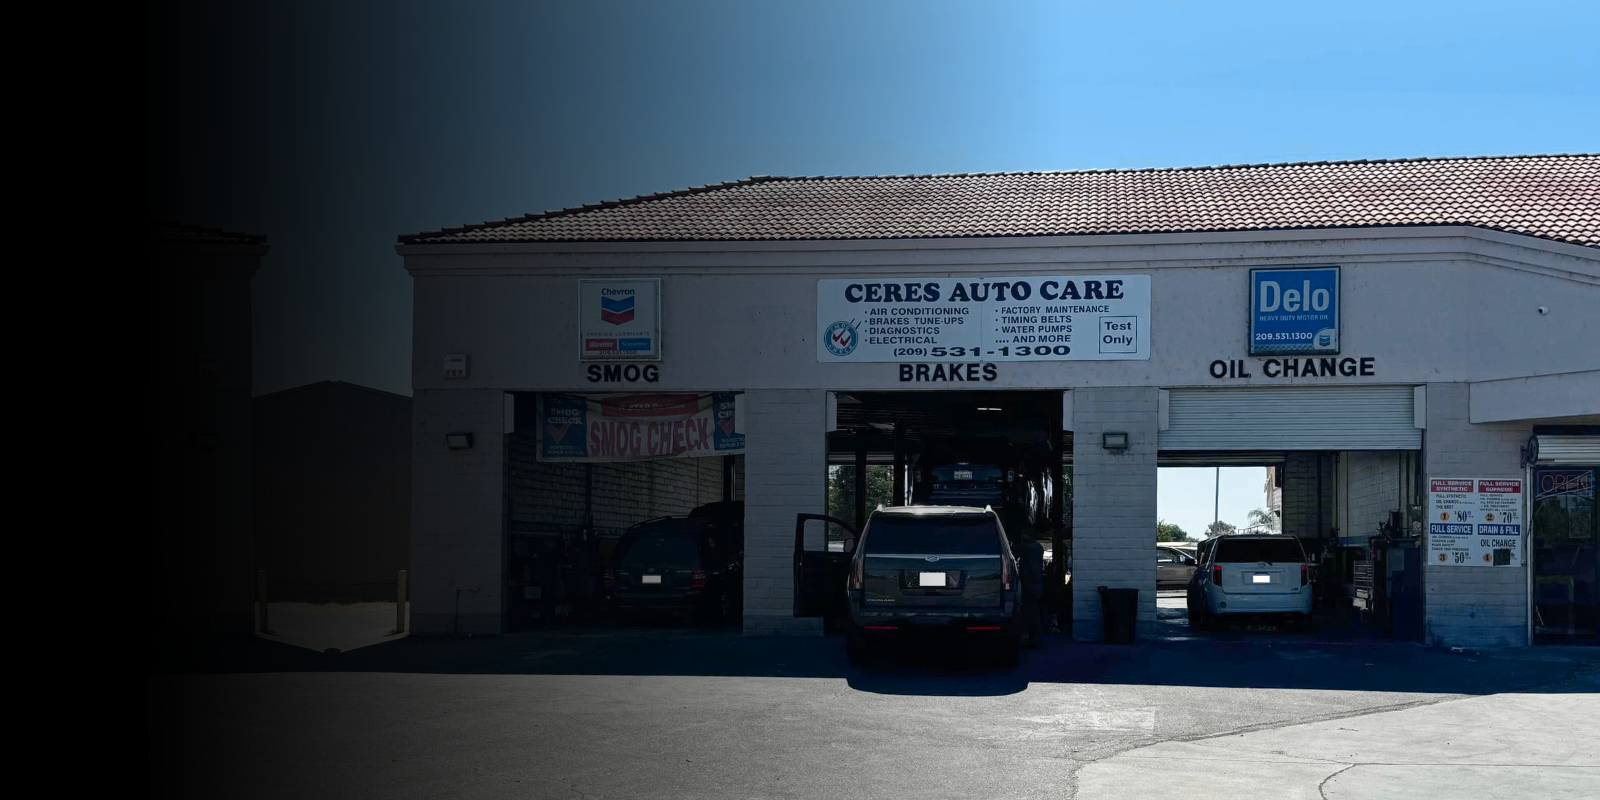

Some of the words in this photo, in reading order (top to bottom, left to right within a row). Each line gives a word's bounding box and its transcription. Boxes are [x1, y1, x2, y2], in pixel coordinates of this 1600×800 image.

[601, 288, 635, 296] Chevron
[845, 283, 940, 303] CERES
[948, 281, 1031, 302] AUTO
[1040, 280, 1124, 300] CARE
[1260, 280, 1330, 312] Delo
[870, 308, 887, 316] AIR
[891, 307, 969, 315] CONDITIONING
[1001, 306, 1041, 314] FACTORY
[1046, 305, 1110, 313] MAINTENANCE
[914, 317, 964, 325] TUNE-UPS
[1002, 316, 1037, 324] TIMING
[1038, 325, 1072, 333] PUMPS
[1105, 321, 1132, 331] Test
[870, 327, 940, 335] DIAGNOSTICS
[870, 336, 937, 344] ELECTRICAL
[1012, 335, 1036, 343] AND
[1103, 335, 1133, 346] Only
[1256, 332, 1313, 341] 209.531.1300
[893, 347, 927, 357] (209)
[931, 345, 1071, 357] 531-1300
[900, 362, 997, 382] BRAKES
[1210, 360, 1251, 379] OIL
[1263, 357, 1375, 378] CHANGE
[587, 364, 659, 382] SMOG
[551, 408, 579, 416] SMOG
[547, 417, 583, 425] CHECK
[590, 421, 641, 456] SMOG
[647, 418, 709, 454] CHECK
[1541, 475, 1588, 493] OPEN
[1432, 525, 1446, 533] FULL
[1447, 525, 1471, 533] SERVICE
[1479, 526, 1498, 534] DRAIN
[1500, 526, 1504, 534] &
[1506, 526, 1518, 534] FILL
[1480, 539, 1490, 547] OIL
[1492, 539, 1516, 547] CHANGE
